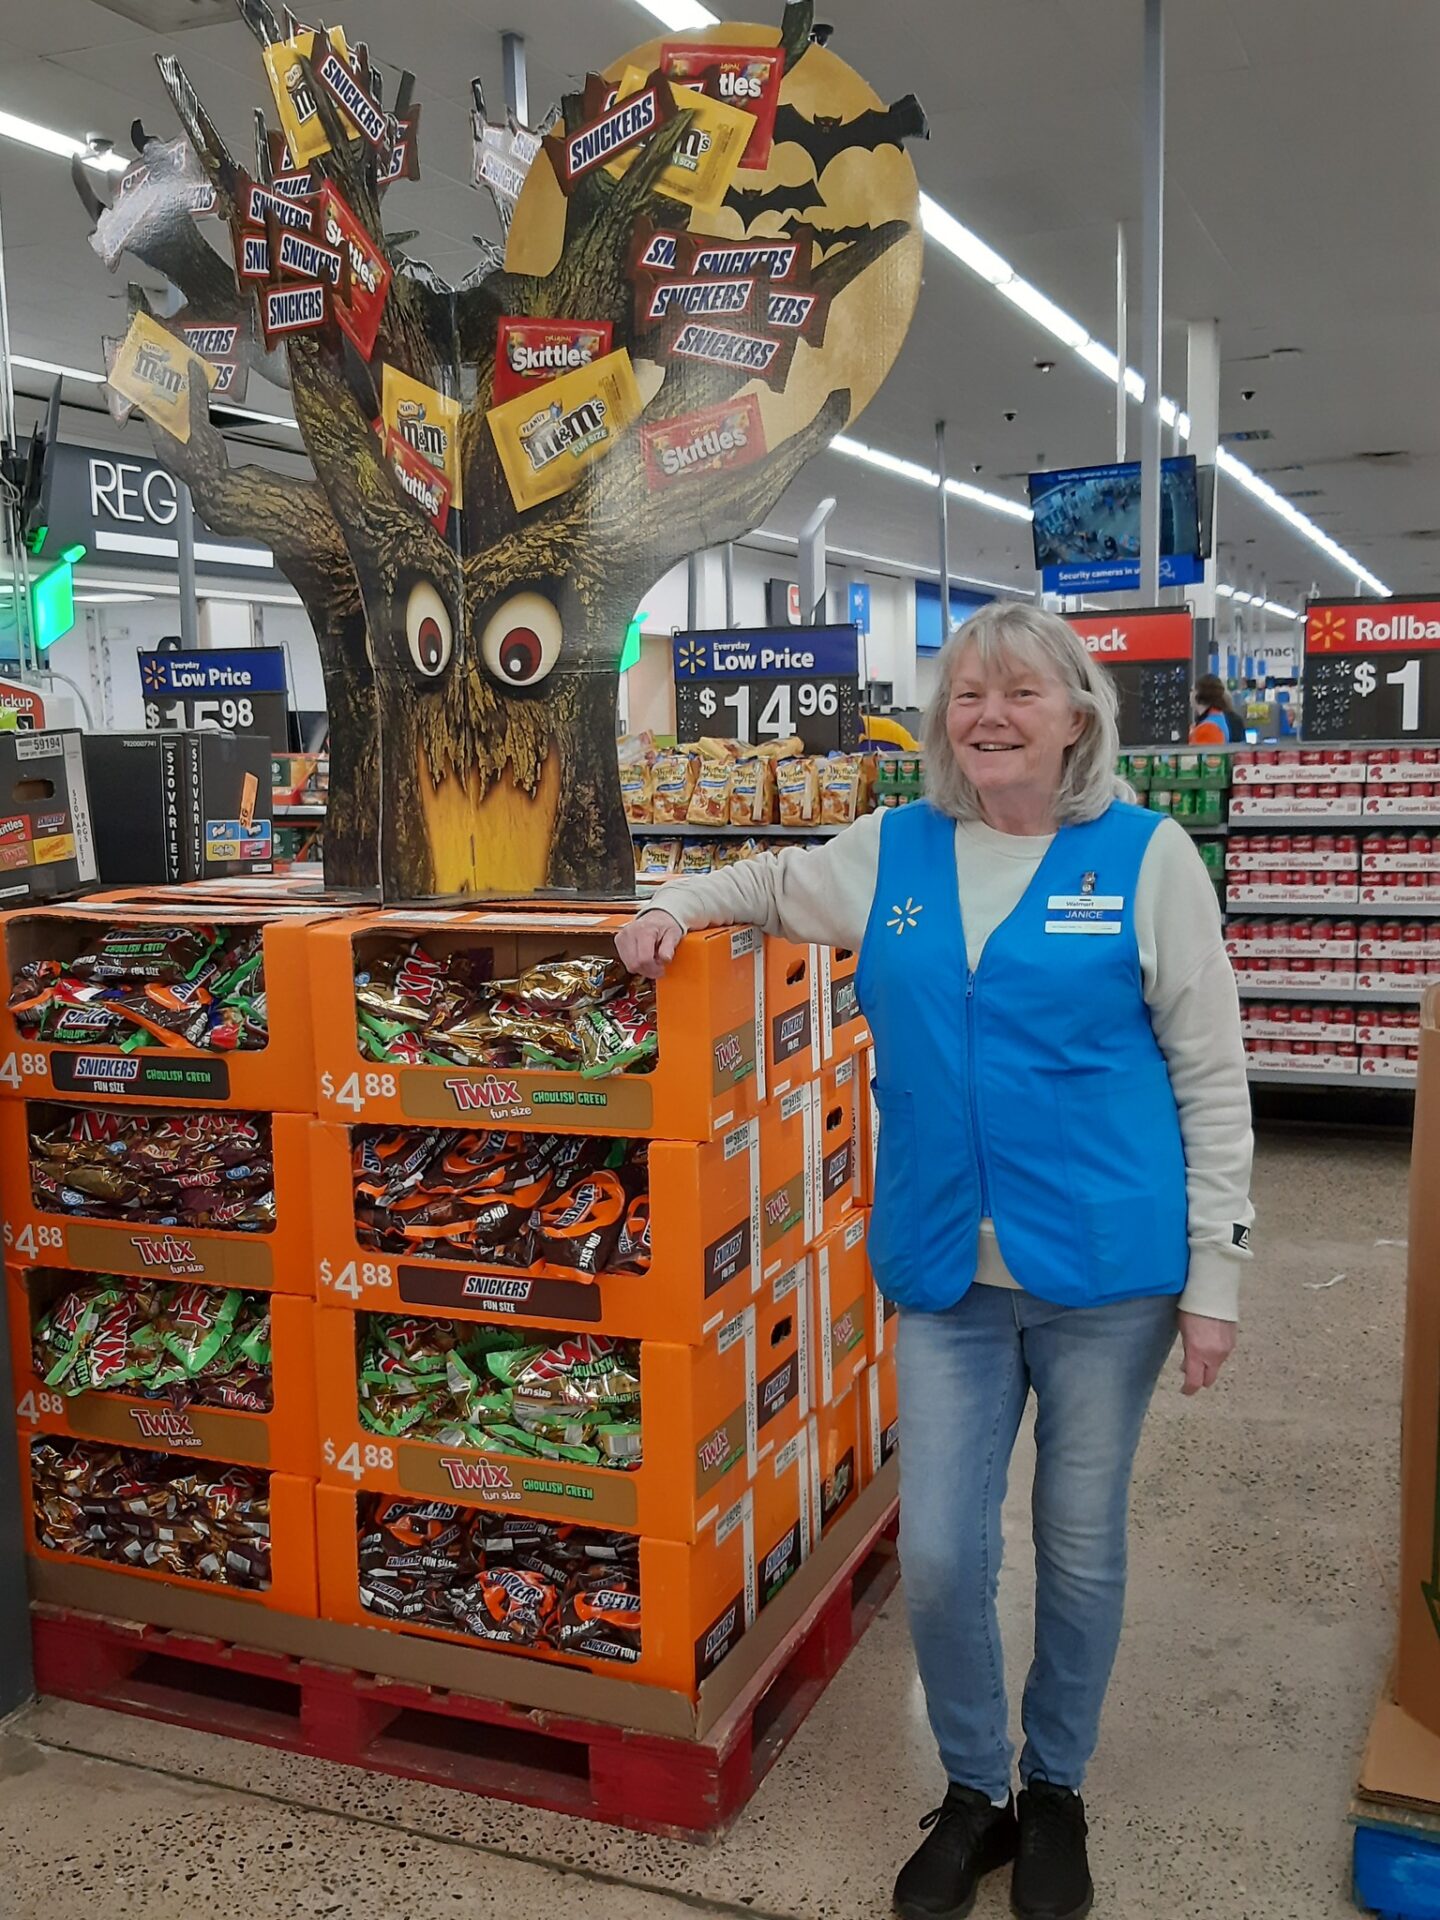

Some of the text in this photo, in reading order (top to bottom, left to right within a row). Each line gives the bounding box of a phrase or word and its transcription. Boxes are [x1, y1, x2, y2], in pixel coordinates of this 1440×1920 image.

[322, 57, 384, 140] SNICKERS
[571, 95, 654, 170] SNICKERS
[269, 290, 322, 327] SNICKERS
[512, 344, 592, 372] Skittles
[676, 325, 776, 369] SNICKERS
[588, 429, 608, 446] SIZE
[662, 424, 748, 476] Skittles
[1059, 570, 1090, 581] Security
[1092, 567, 1122, 578] cameras
[1125, 567, 1132, 575] in
[714, 642, 750, 652] Everyday
[713, 648, 815, 671] Low Price
[171, 667, 252, 688] Low Price
[34, 736, 60, 750] 59194
[1065, 910, 1104, 919] JANICE
[714, 1034, 741, 1072] Twix
[76, 1057, 137, 1079] SNICKERS
[146, 1068, 212, 1083] GHOULISH GREEN
[93, 1081, 126, 1093] FUN SIZE
[445, 1074, 523, 1111] Twix
[532, 1091, 608, 1106] GHOULISH GREEN
[489, 1106, 533, 1120] fun size
[765, 1190, 790, 1225] Twix
[132, 1234, 196, 1266] Twix
[578, 1232, 602, 1269] FUN SIZE
[714, 1232, 743, 1271] SNICKERS
[170, 1263, 205, 1274] fun size
[466, 1276, 530, 1298] SNICKERS
[483, 1300, 516, 1313] FUN SIZE
[517, 1385, 552, 1399] fun size
[130, 1408, 194, 1438] Twix
[168, 1437, 202, 1447] fun size
[698, 1429, 729, 1471] Twix
[441, 1458, 513, 1489] Twix
[482, 1488, 522, 1501] fun size
[522, 1479, 594, 1501] GHOULISH GREEN
[422, 1556, 437, 1568] FUN
[371, 1580, 404, 1601] SNICKERS
[581, 1640, 636, 1660] SNICKERS FUN
